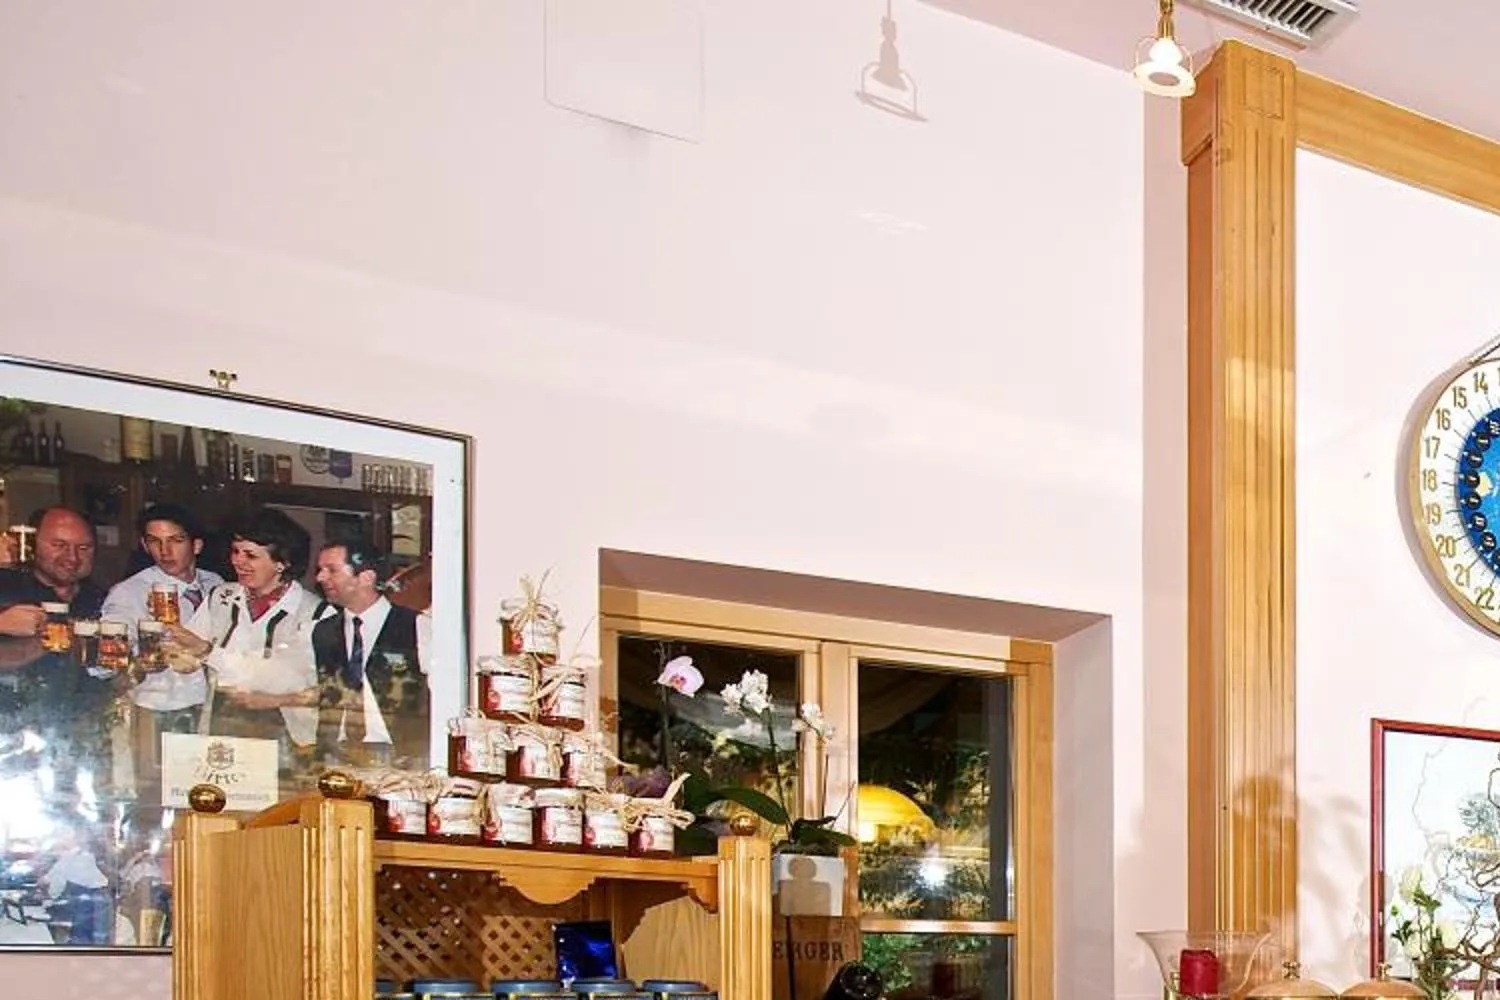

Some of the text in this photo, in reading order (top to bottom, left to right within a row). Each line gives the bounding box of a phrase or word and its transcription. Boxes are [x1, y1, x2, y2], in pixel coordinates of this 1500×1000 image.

[1473, 371, 1488, 394] 14
[1452, 386, 1467, 408] 15
[1436, 408, 1451, 430] 16
[1425, 435, 1441, 459] 17
[1422, 468, 1437, 491] 18
[1425, 502, 1441, 526] 19
[1436, 534, 1455, 558] 20
[1454, 564, 1471, 588] 21
[1474, 586, 1496, 611] 22
